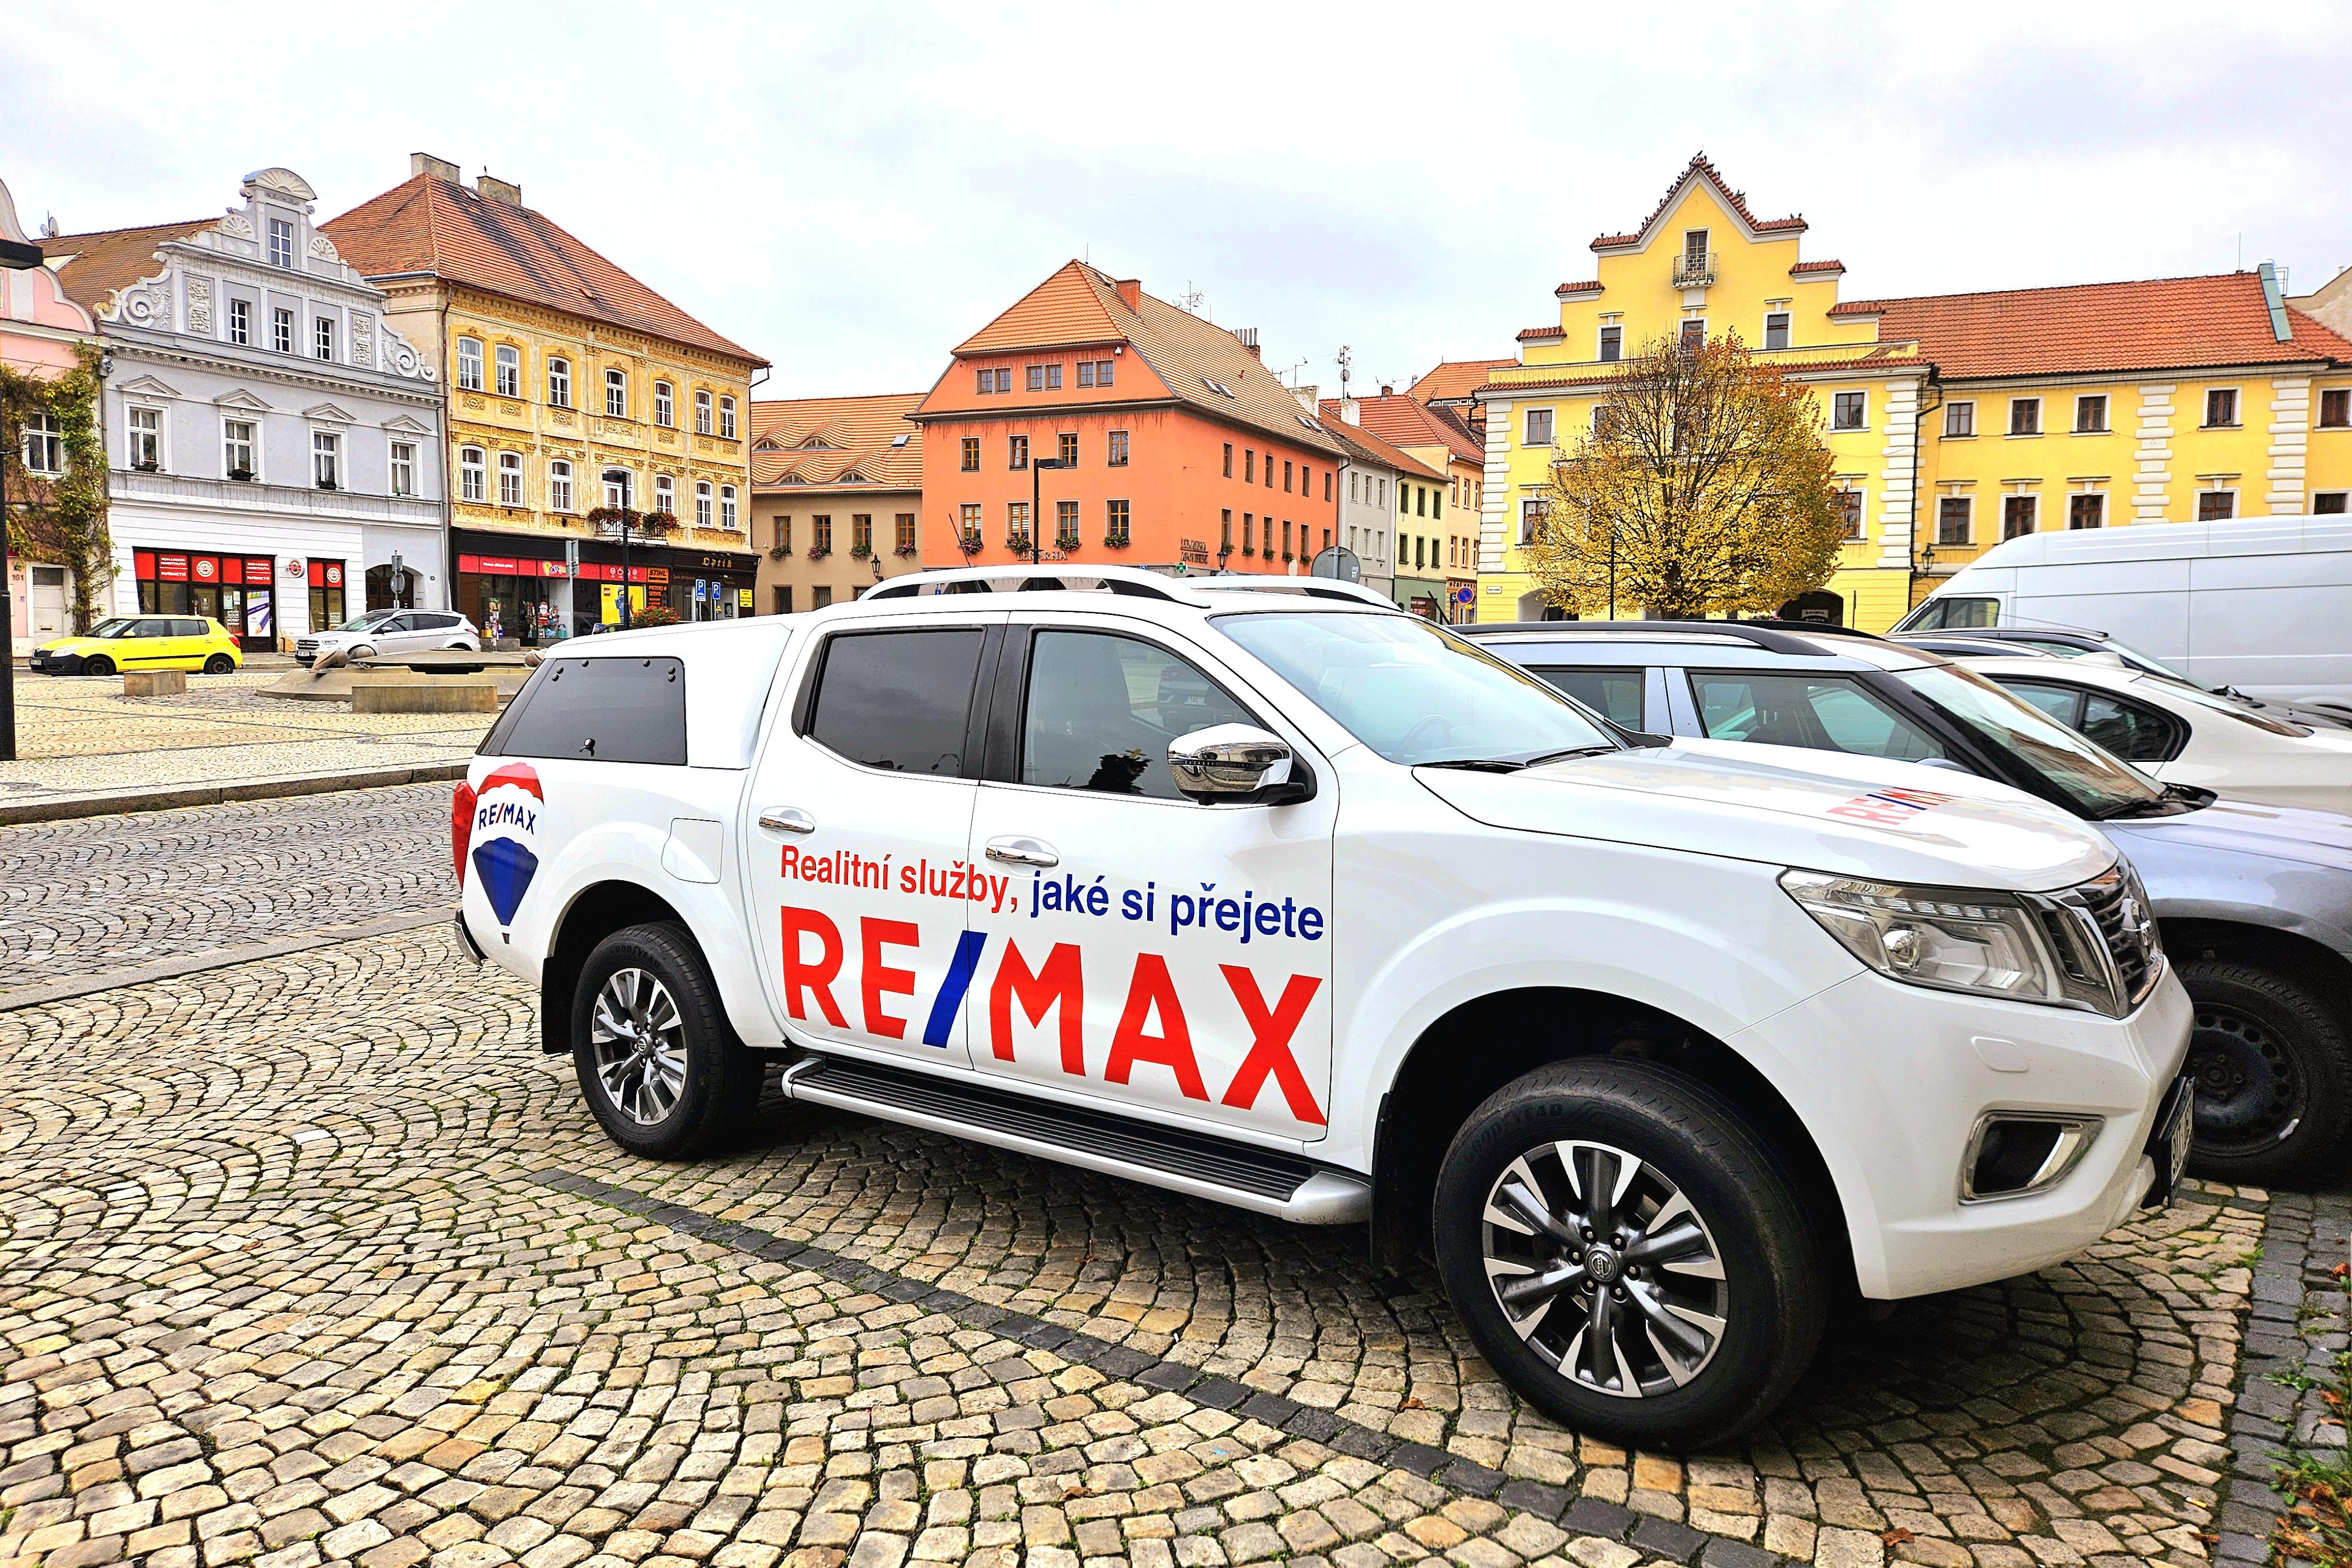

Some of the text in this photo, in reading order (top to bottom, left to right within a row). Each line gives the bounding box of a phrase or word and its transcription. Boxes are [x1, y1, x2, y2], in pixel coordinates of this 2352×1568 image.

[698, 581, 704, 591] P
[714, 584, 719, 594] P
[479, 803, 536, 836] RE/MAX
[781, 845, 1324, 944] Realitní služby, jaké si přejete
[781, 905, 1327, 1126] RE/MAX
